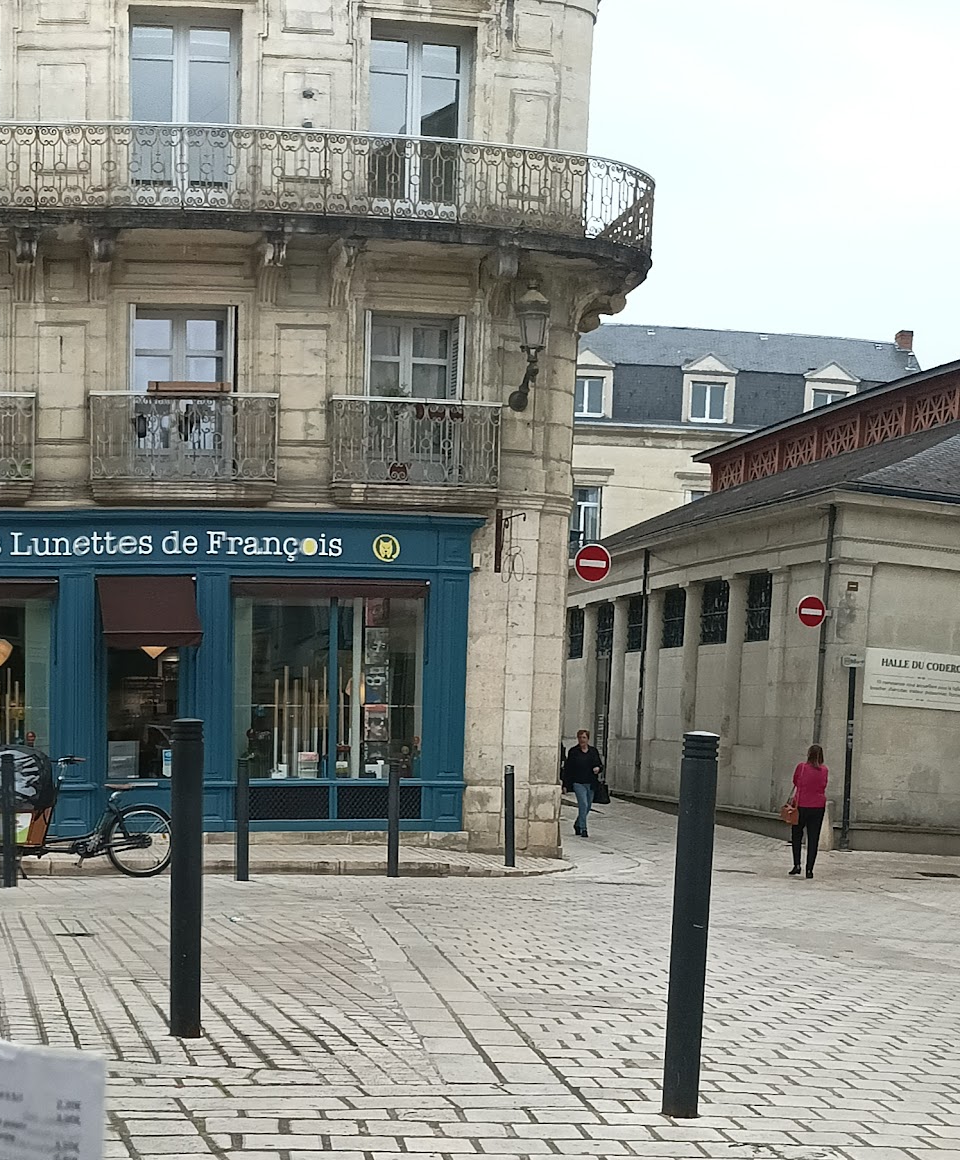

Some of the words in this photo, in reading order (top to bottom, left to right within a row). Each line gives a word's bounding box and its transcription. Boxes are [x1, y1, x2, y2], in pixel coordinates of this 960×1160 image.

[10, 531, 153, 557] Lunettes
[161, 530, 198, 555] de
[206, 530, 343, 562] François
[881, 658, 910, 669] HALLE
[911, 660, 925, 670] DU
